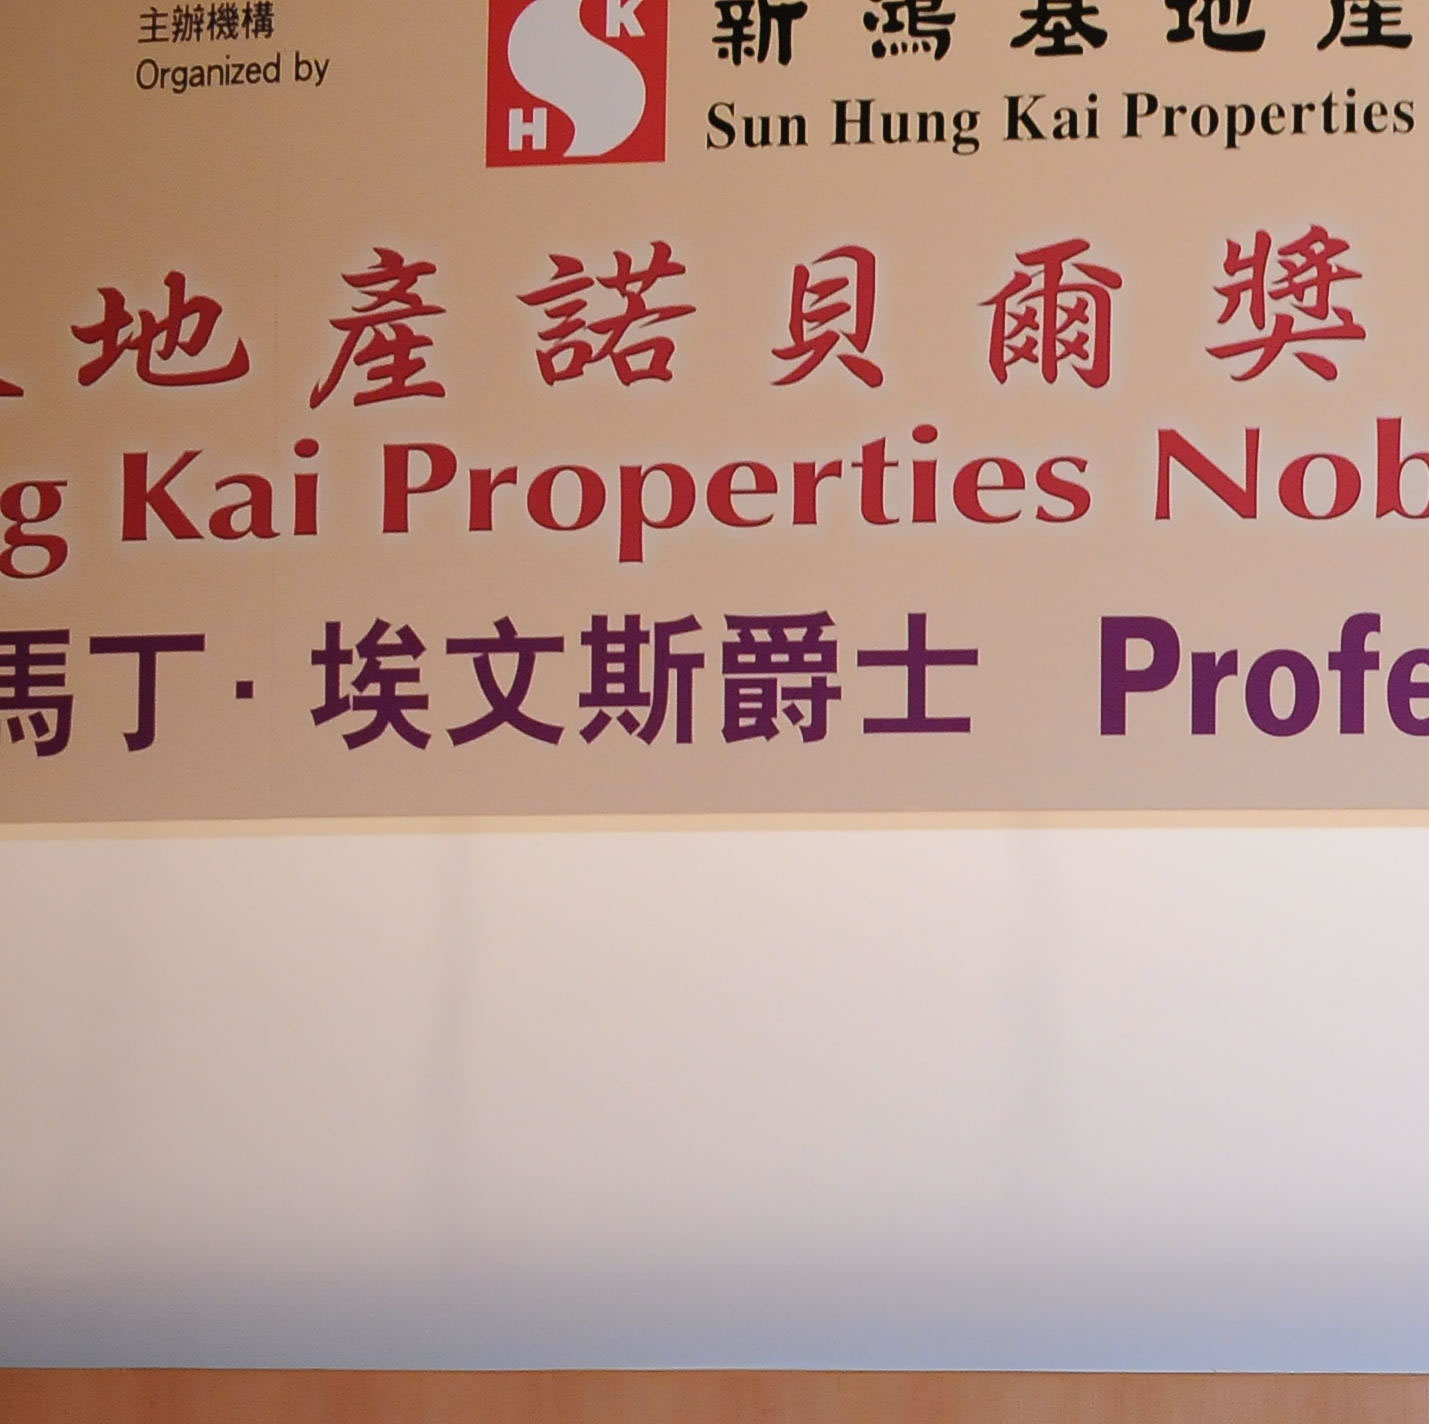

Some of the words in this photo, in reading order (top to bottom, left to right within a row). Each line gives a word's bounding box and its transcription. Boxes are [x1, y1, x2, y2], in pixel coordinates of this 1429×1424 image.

[137, 1, 275, 44] 主辦機構
[136, 52, 282, 95] Organized
[294, 50, 330, 87] by
[705, 101, 809, 150] Sun
[830, 98, 981, 156] Hung
[1003, 92, 1099, 141] Kai
[1122, 87, 1415, 150] Properties
[122, 438, 320, 541] Kai
[383, 424, 1091, 563] Properties
